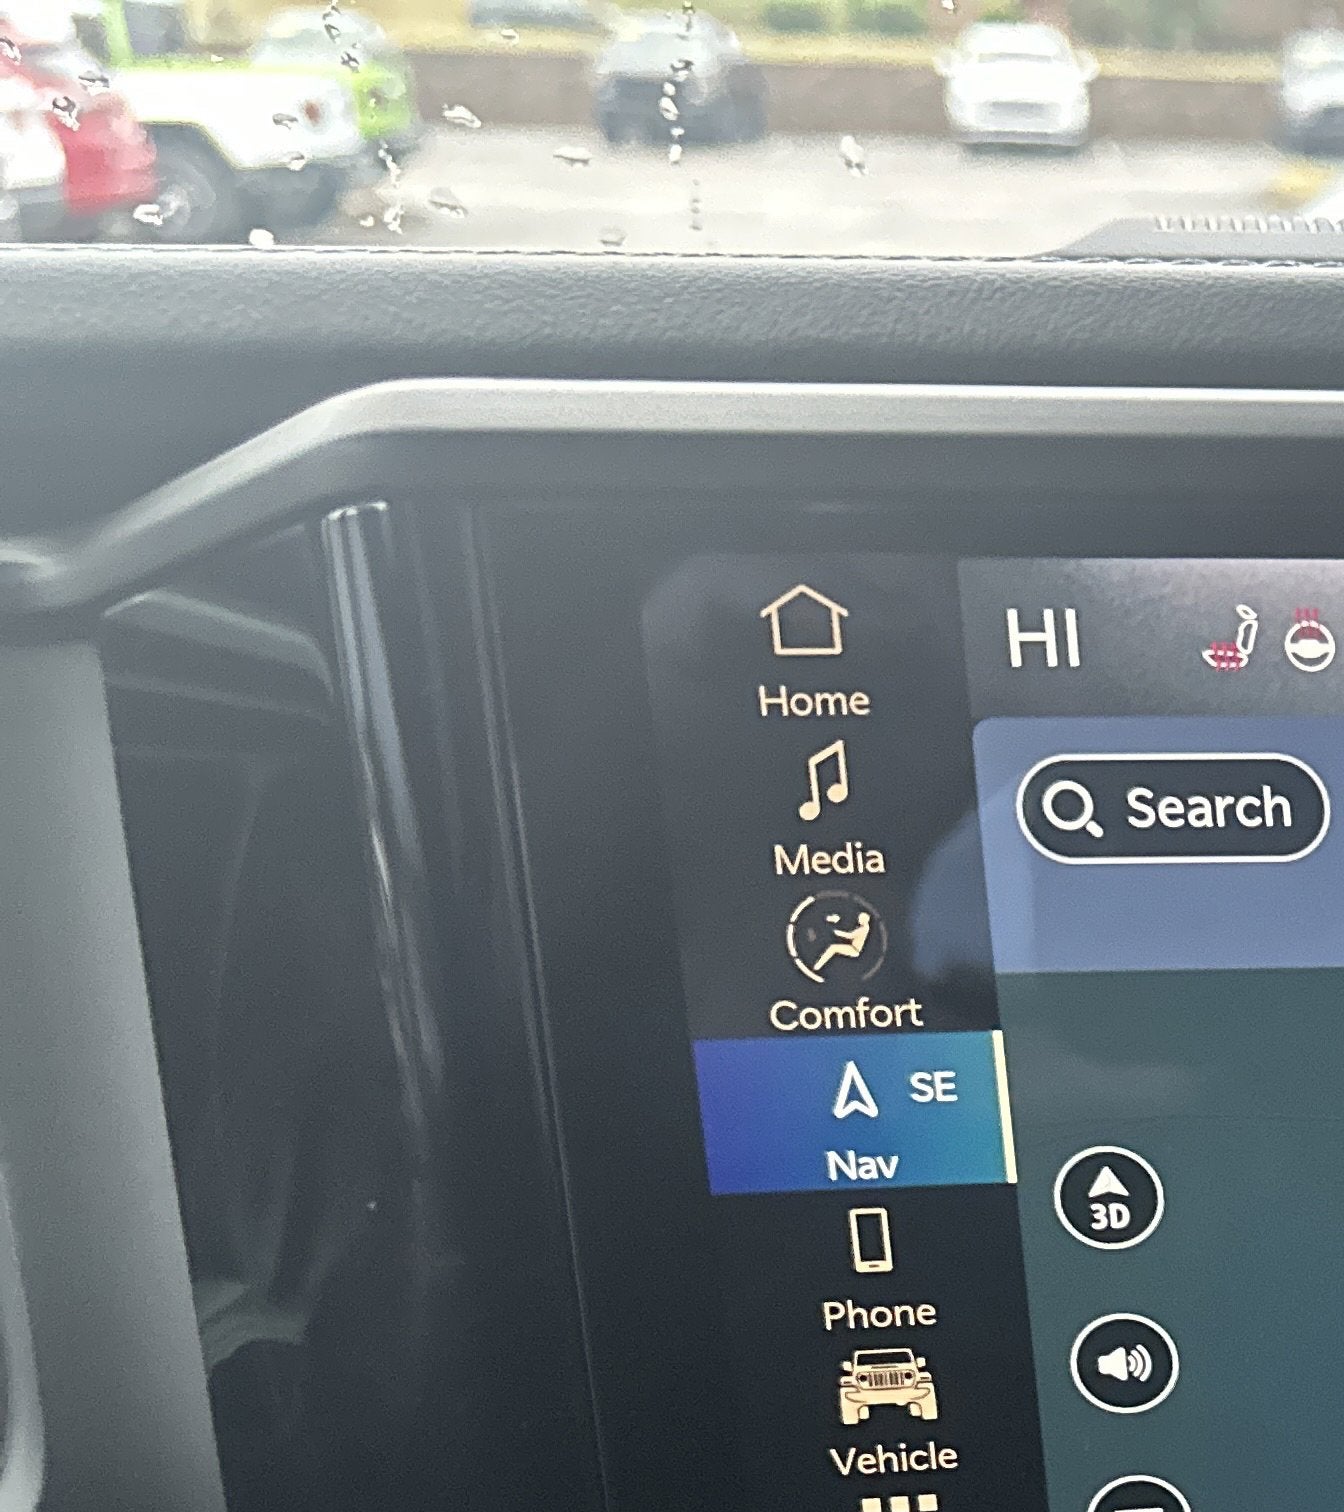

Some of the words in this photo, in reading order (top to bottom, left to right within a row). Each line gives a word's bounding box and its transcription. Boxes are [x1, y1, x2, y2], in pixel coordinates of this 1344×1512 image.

[1007, 608, 1080, 667] HI
[759, 685, 870, 716] Home
[1127, 785, 1291, 827] Search
[775, 842, 885, 875] Media
[771, 997, 923, 1030] Comfort
[910, 1071, 958, 1102] SE
[826, 1150, 898, 1180] Nav
[1090, 1203, 1130, 1229] 3D
[824, 1300, 936, 1330] Phone
[830, 1442, 958, 1475] Vehicle
